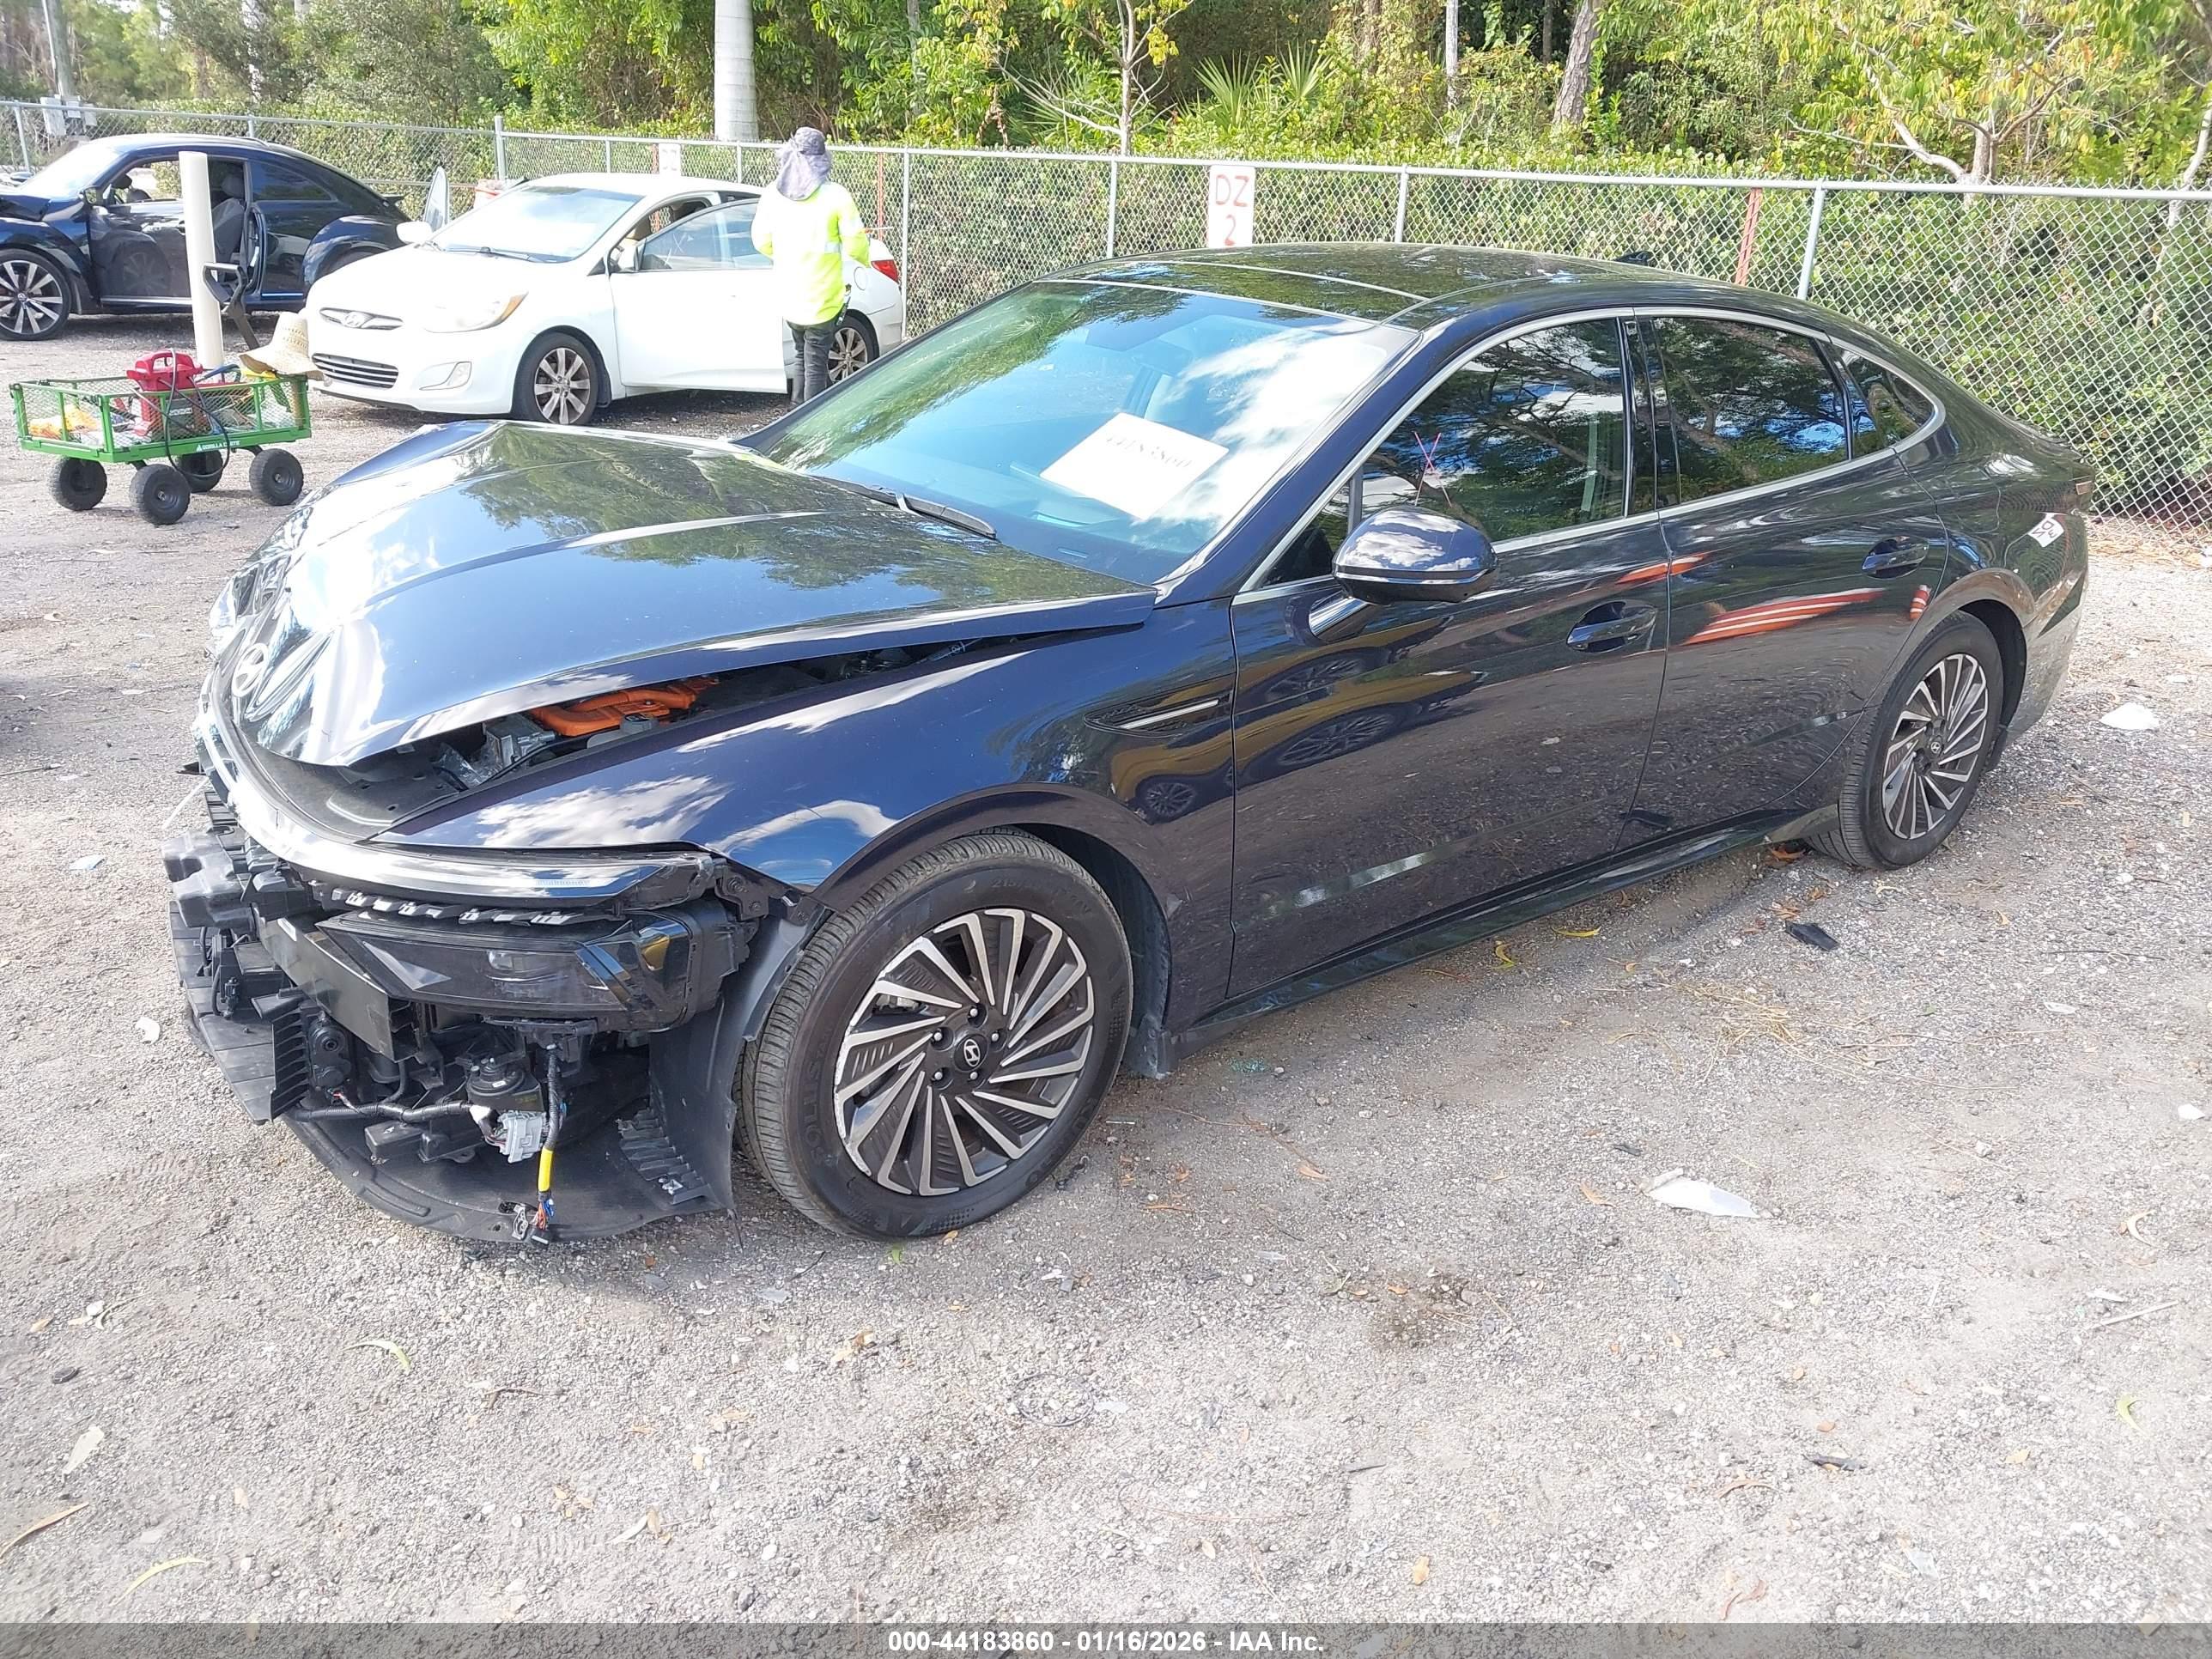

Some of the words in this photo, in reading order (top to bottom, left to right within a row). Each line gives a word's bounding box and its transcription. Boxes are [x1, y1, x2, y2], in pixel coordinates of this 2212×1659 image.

[1216, 174, 1249, 207] DZ
[1224, 214, 1237, 246] 2
[802, 1060, 824, 1165] SOLUS
